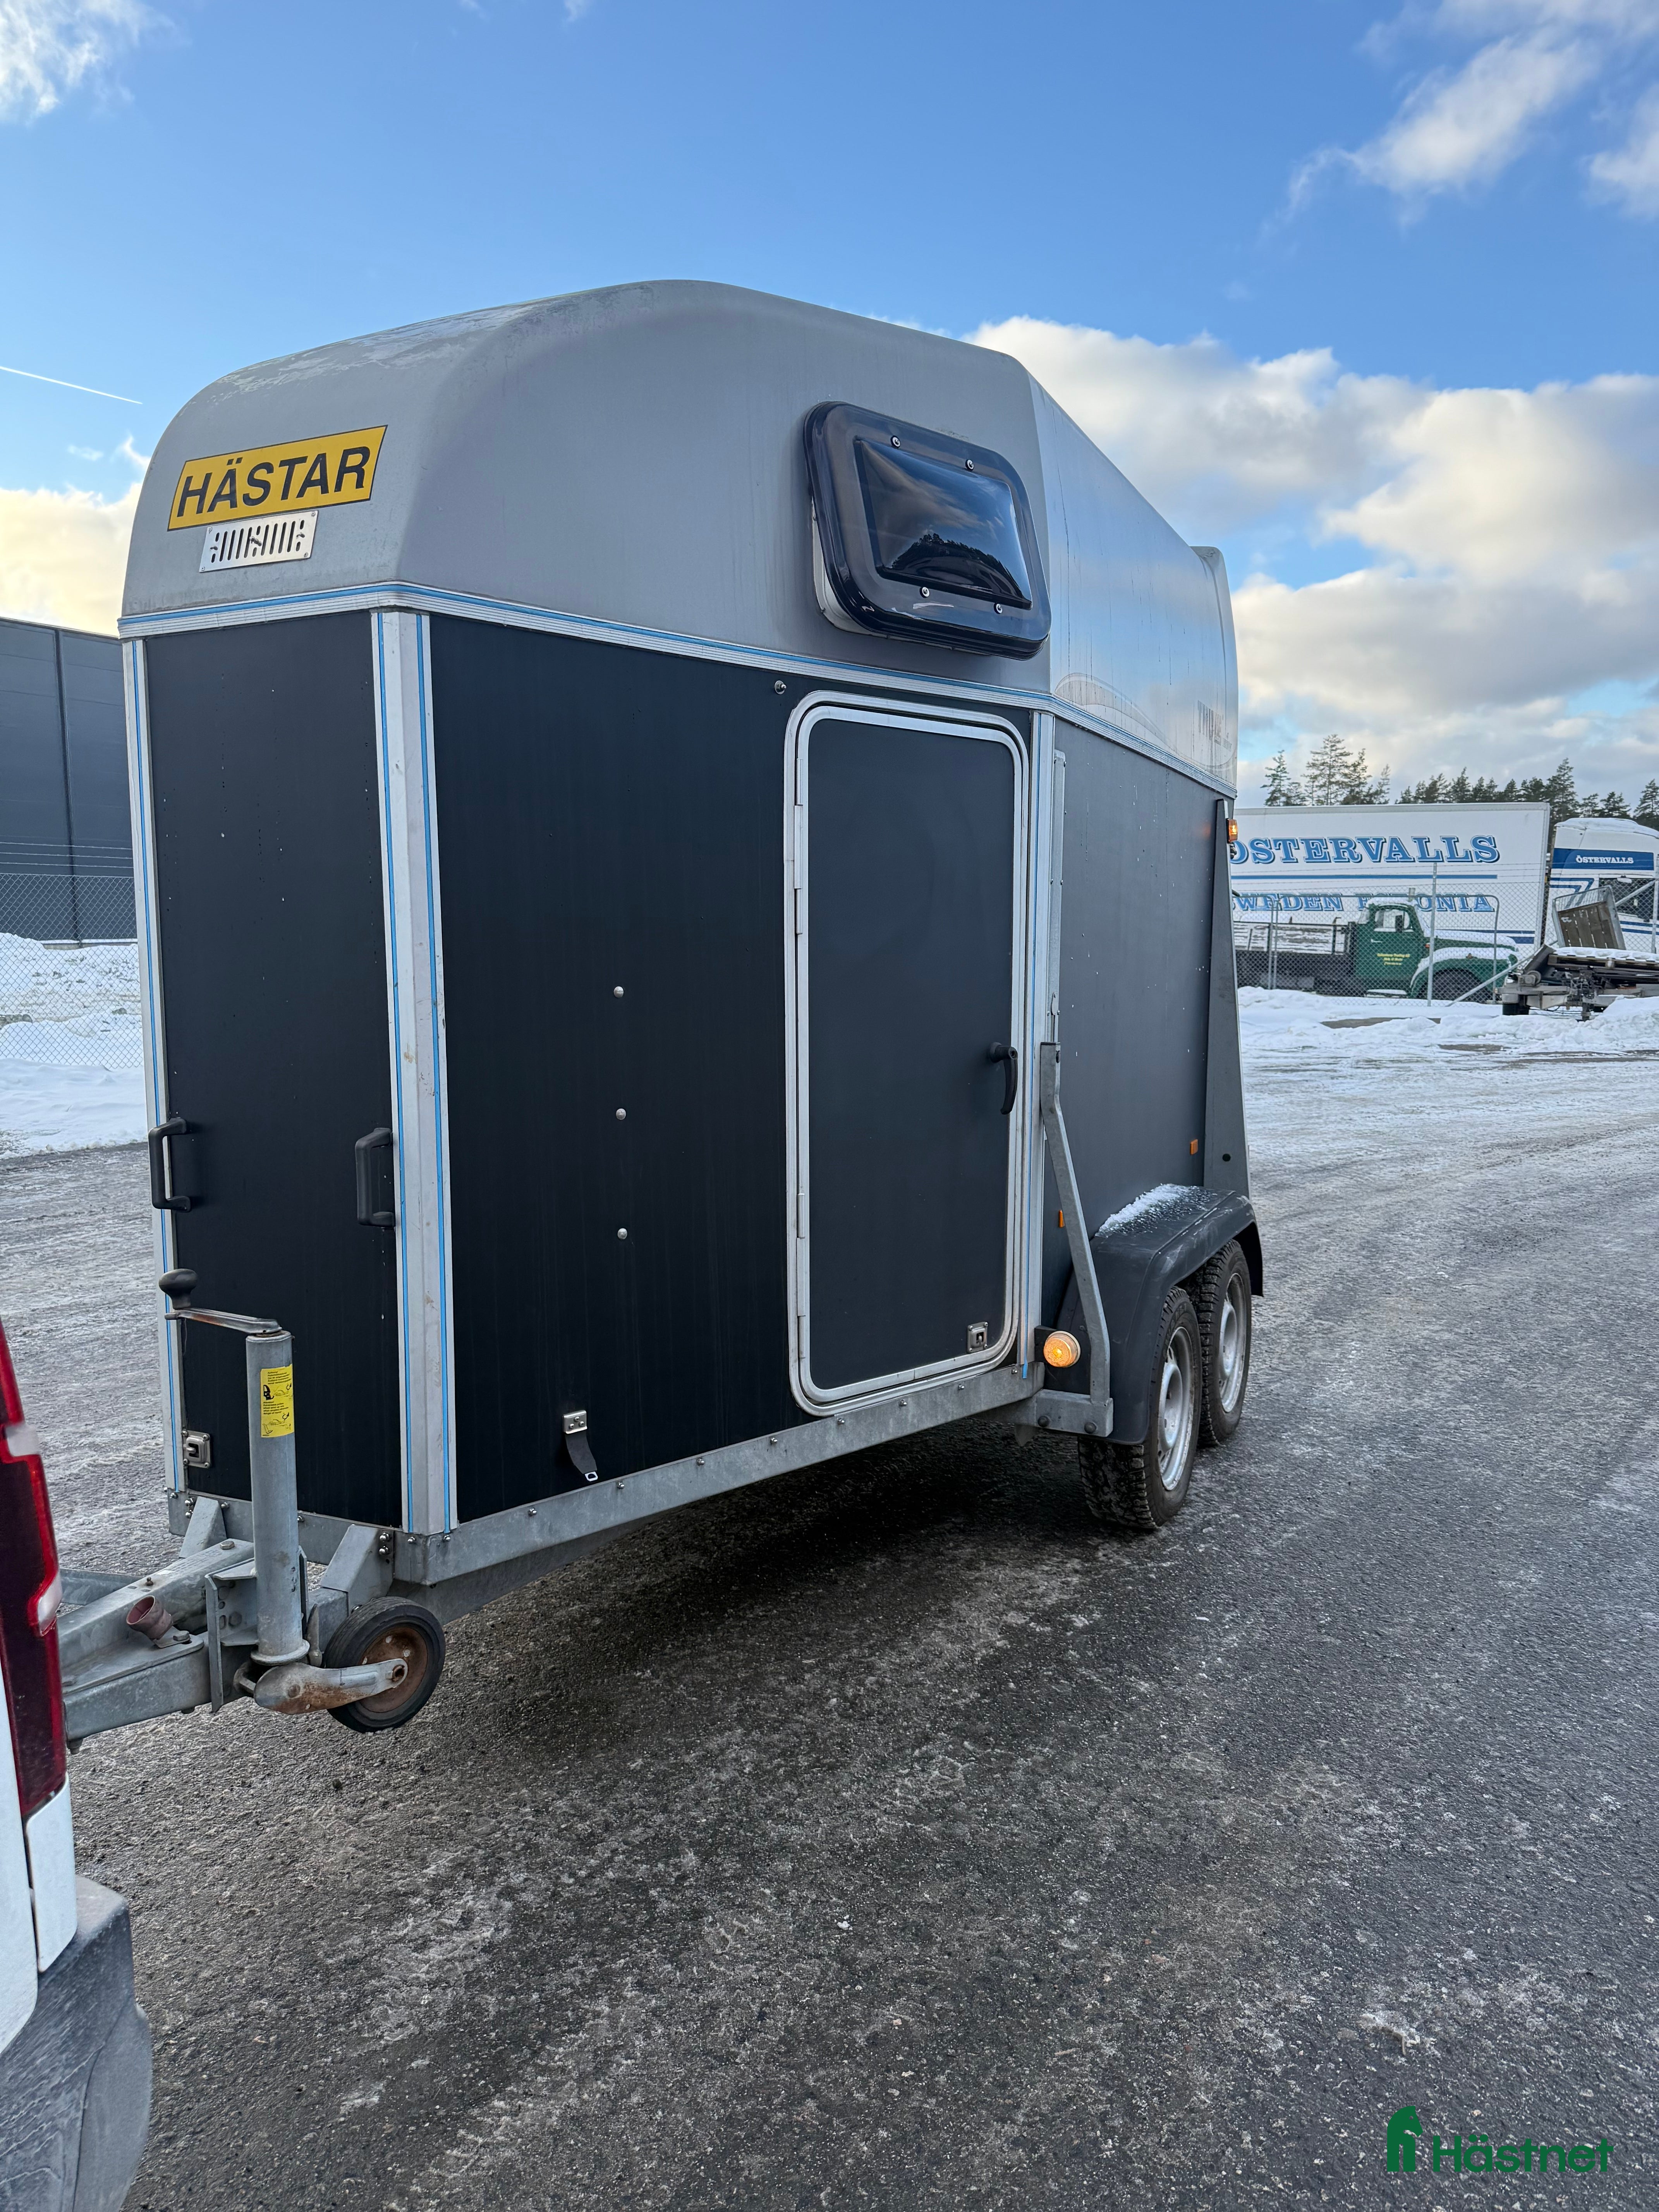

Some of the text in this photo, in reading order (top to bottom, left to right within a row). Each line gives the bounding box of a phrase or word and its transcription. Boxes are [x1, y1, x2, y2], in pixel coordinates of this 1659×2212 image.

[177, 446, 371, 517] HÄSTAR
[1576, 855, 1634, 864] ÖSTERVALLS
[1232, 892, 1495, 912] WEDEN EONIA
